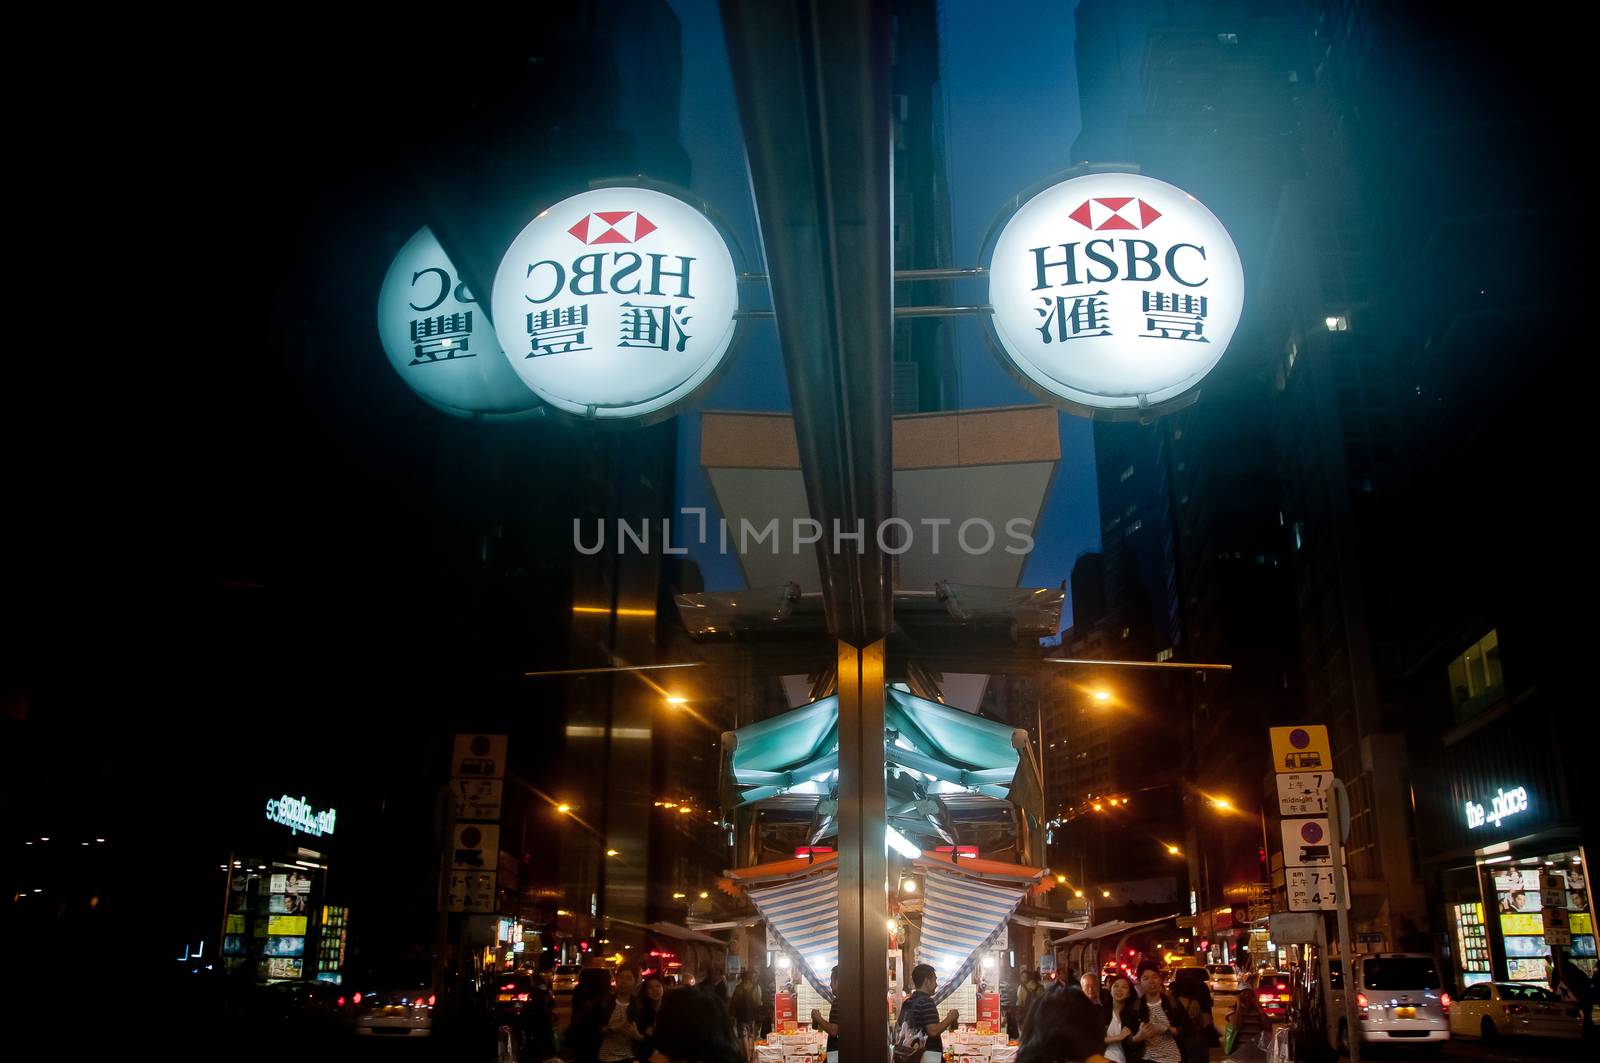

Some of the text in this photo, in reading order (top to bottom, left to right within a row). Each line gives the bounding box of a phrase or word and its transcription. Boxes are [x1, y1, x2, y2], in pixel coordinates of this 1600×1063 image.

[1029, 238, 1209, 291] HSBC
[1313, 774, 1322, 788] 7
[1466, 800, 1485, 829] the
